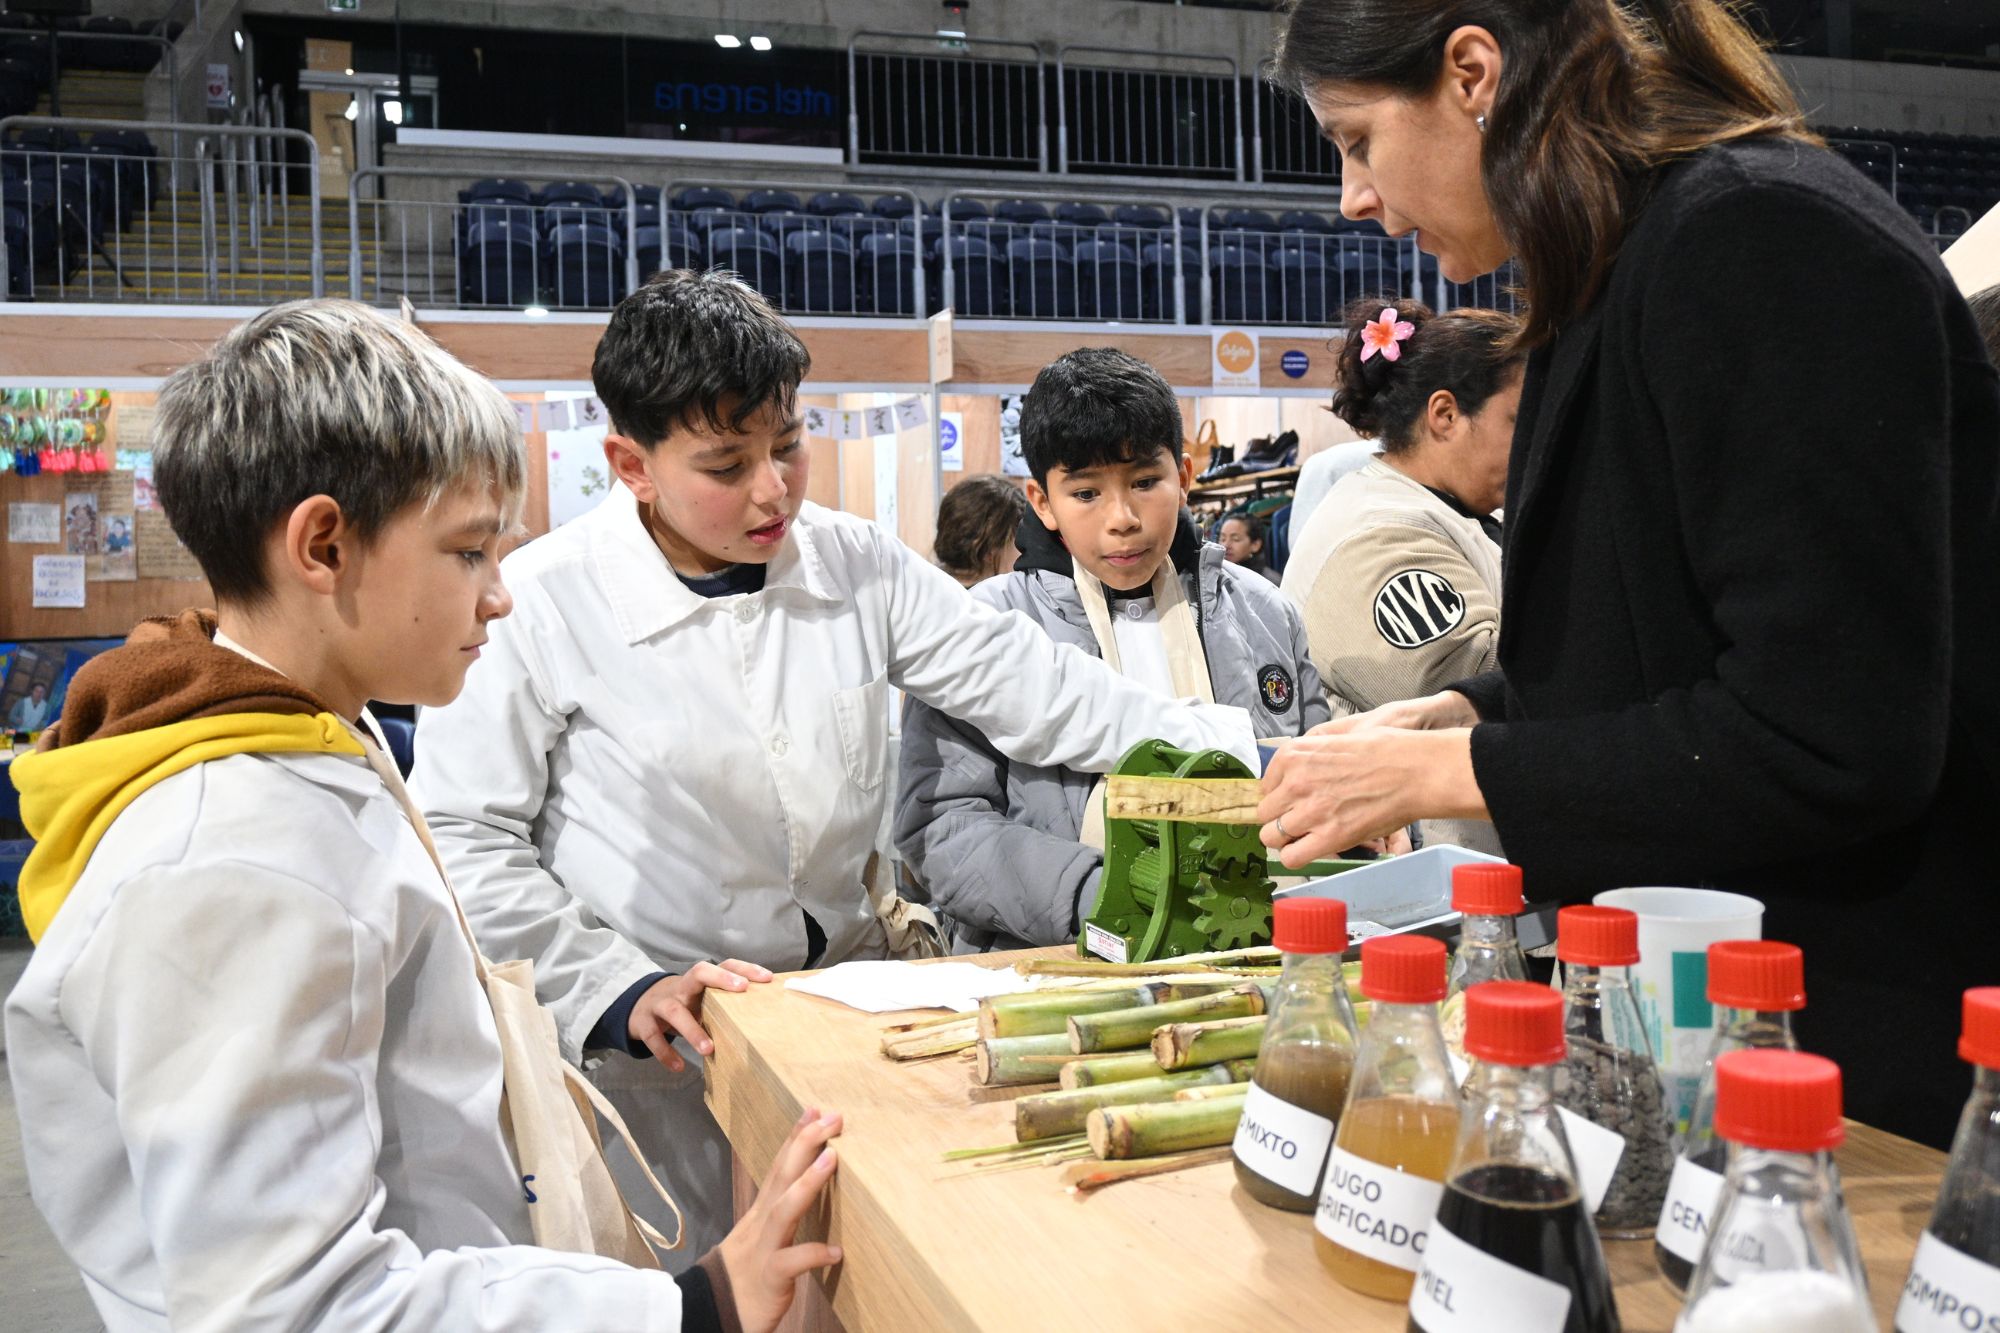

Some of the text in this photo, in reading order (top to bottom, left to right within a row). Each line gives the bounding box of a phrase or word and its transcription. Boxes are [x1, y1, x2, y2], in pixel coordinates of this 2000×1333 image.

[1377, 572, 1461, 645] NYC
[1246, 1118, 1297, 1159] MIXTO
[1330, 1165, 1382, 1202] JUGO
[1319, 1195, 1429, 1254] ARIFICADO
[1421, 1265, 1455, 1312] MIEL
